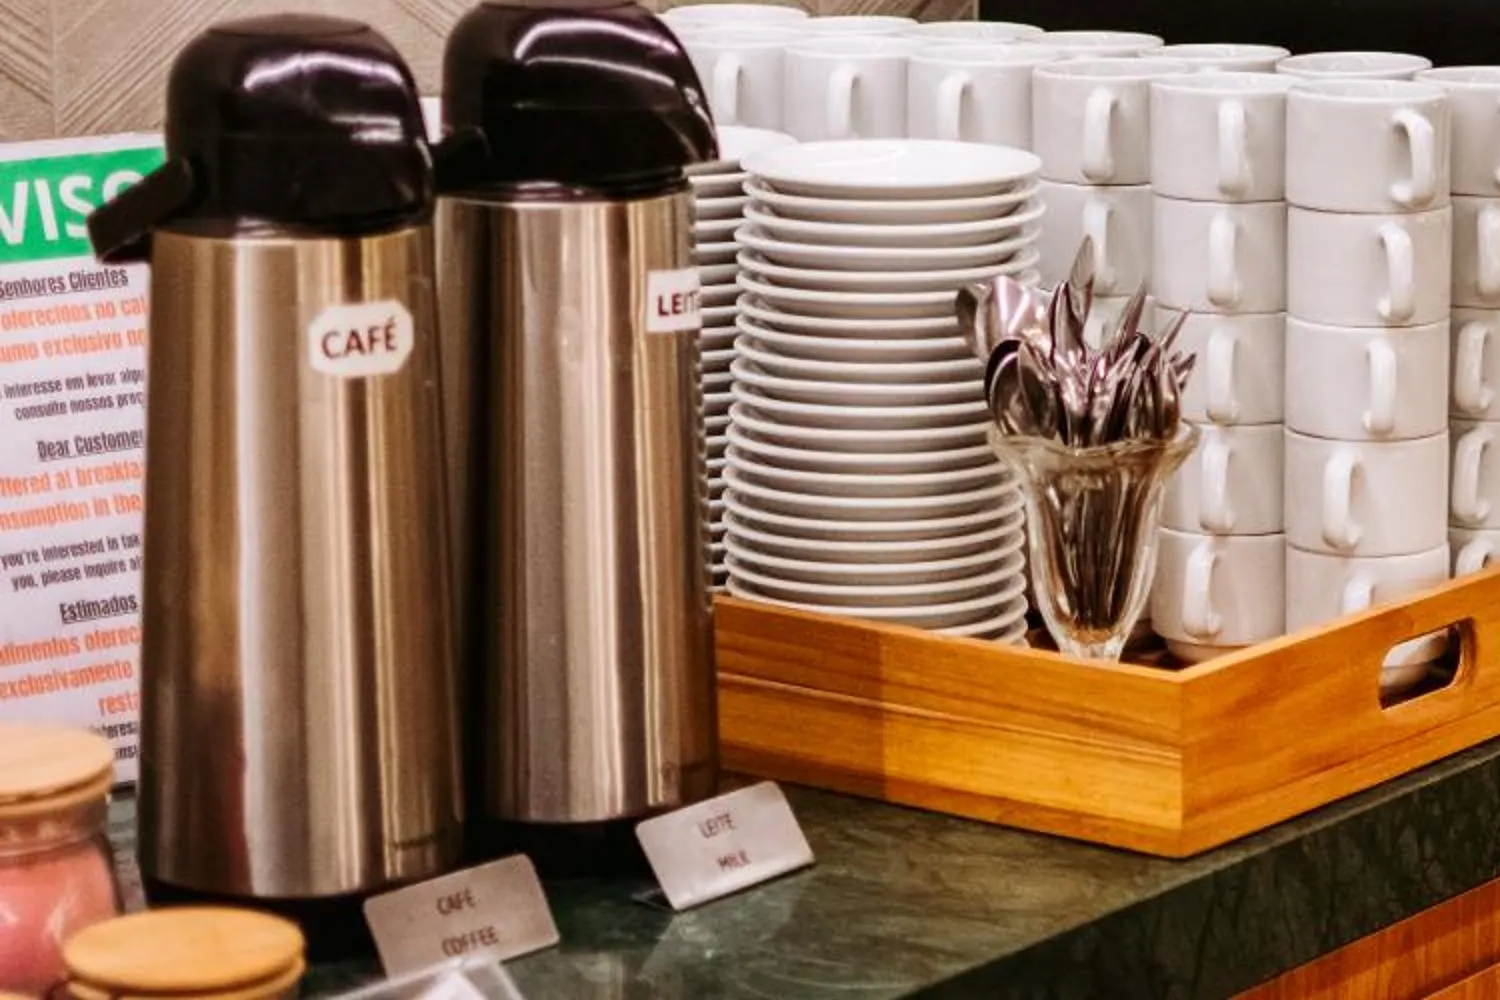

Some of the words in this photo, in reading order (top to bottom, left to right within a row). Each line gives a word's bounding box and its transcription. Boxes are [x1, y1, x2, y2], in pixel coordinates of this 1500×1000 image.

[69, 267, 129, 291] Clientes
[43, 332, 122, 357] exclusivo
[321, 316, 397, 360] CAFÉ
[70, 396, 114, 414] nossos
[37, 439, 70, 459] Dear
[42, 538, 105, 562] interested
[41, 567, 82, 587] please
[60, 595, 137, 620] Estimados
